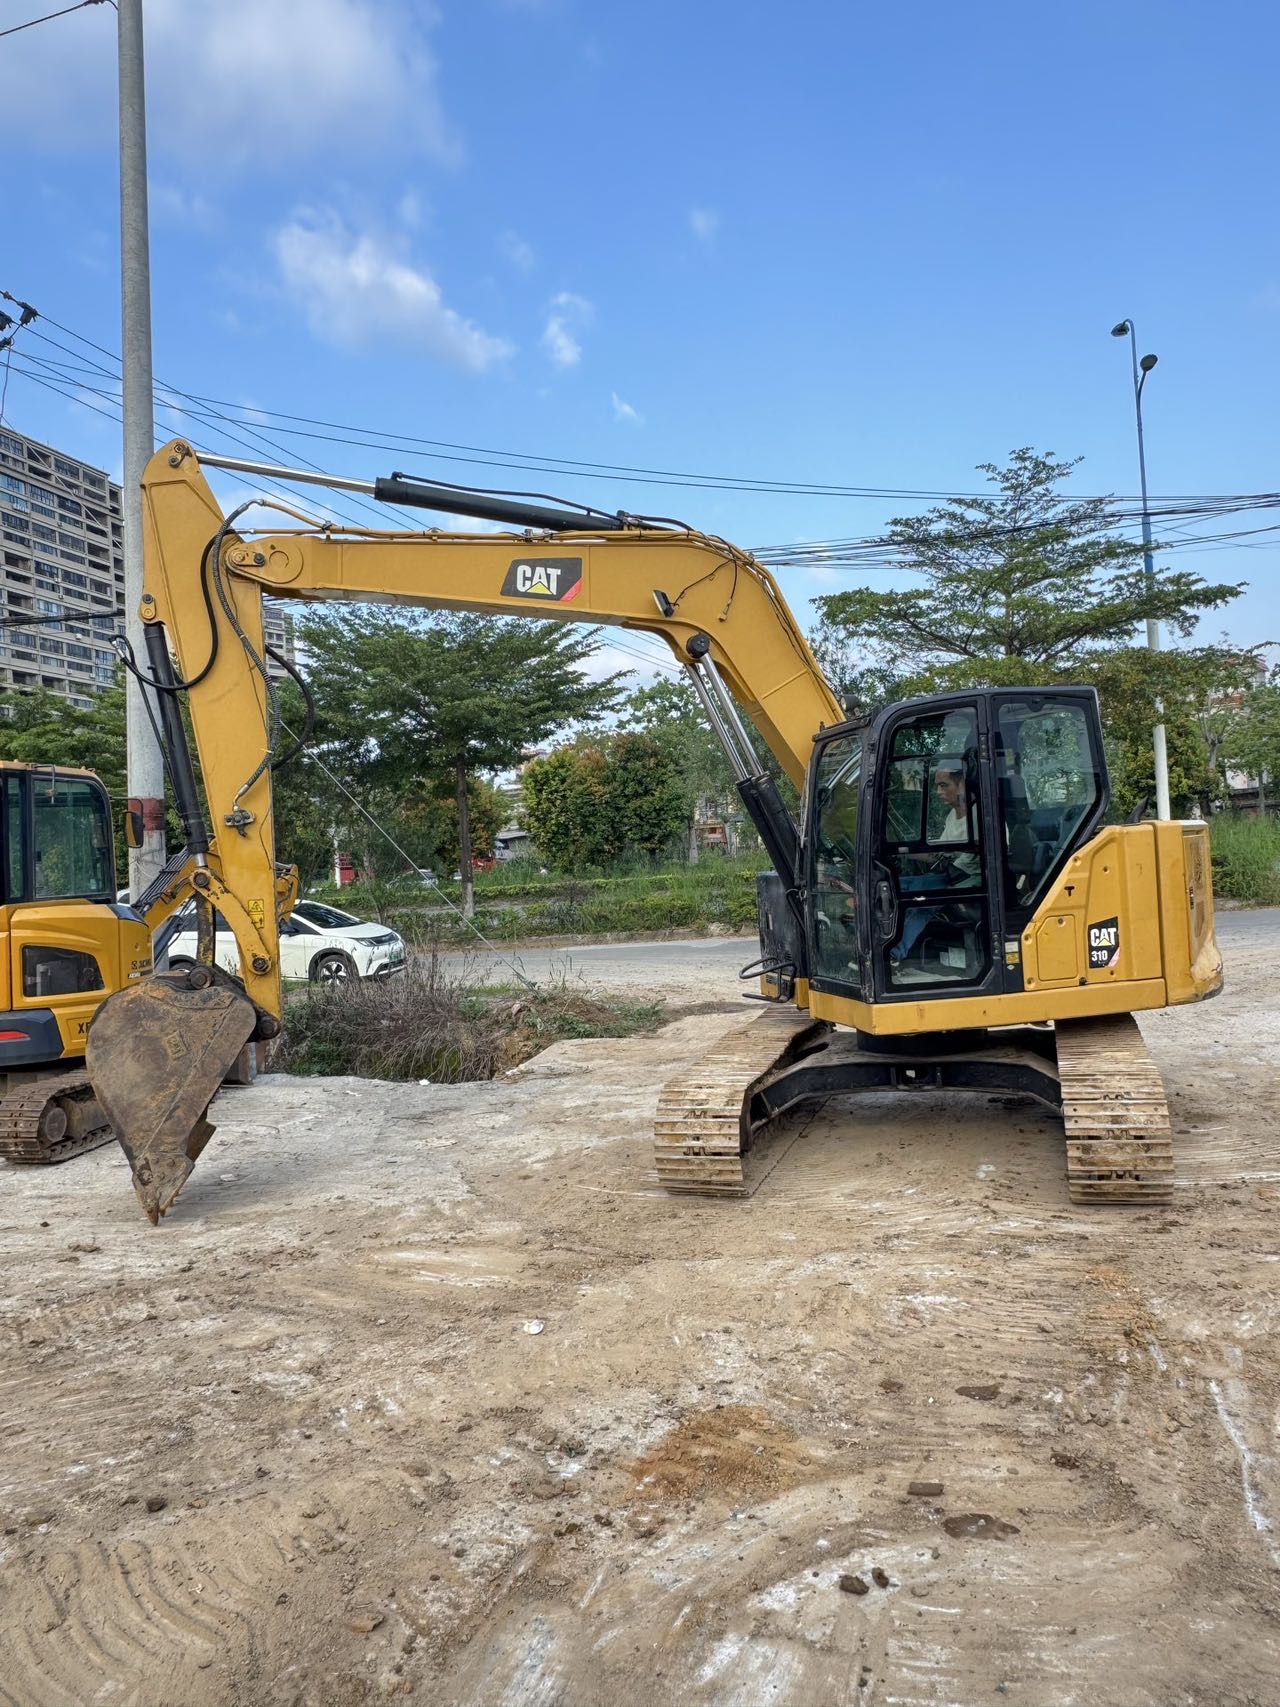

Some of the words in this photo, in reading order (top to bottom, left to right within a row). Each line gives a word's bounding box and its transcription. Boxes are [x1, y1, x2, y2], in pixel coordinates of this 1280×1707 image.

[516, 564, 561, 595] CAT
[1090, 927, 1117, 947] CAT
[1091, 950, 1108, 961] 310
